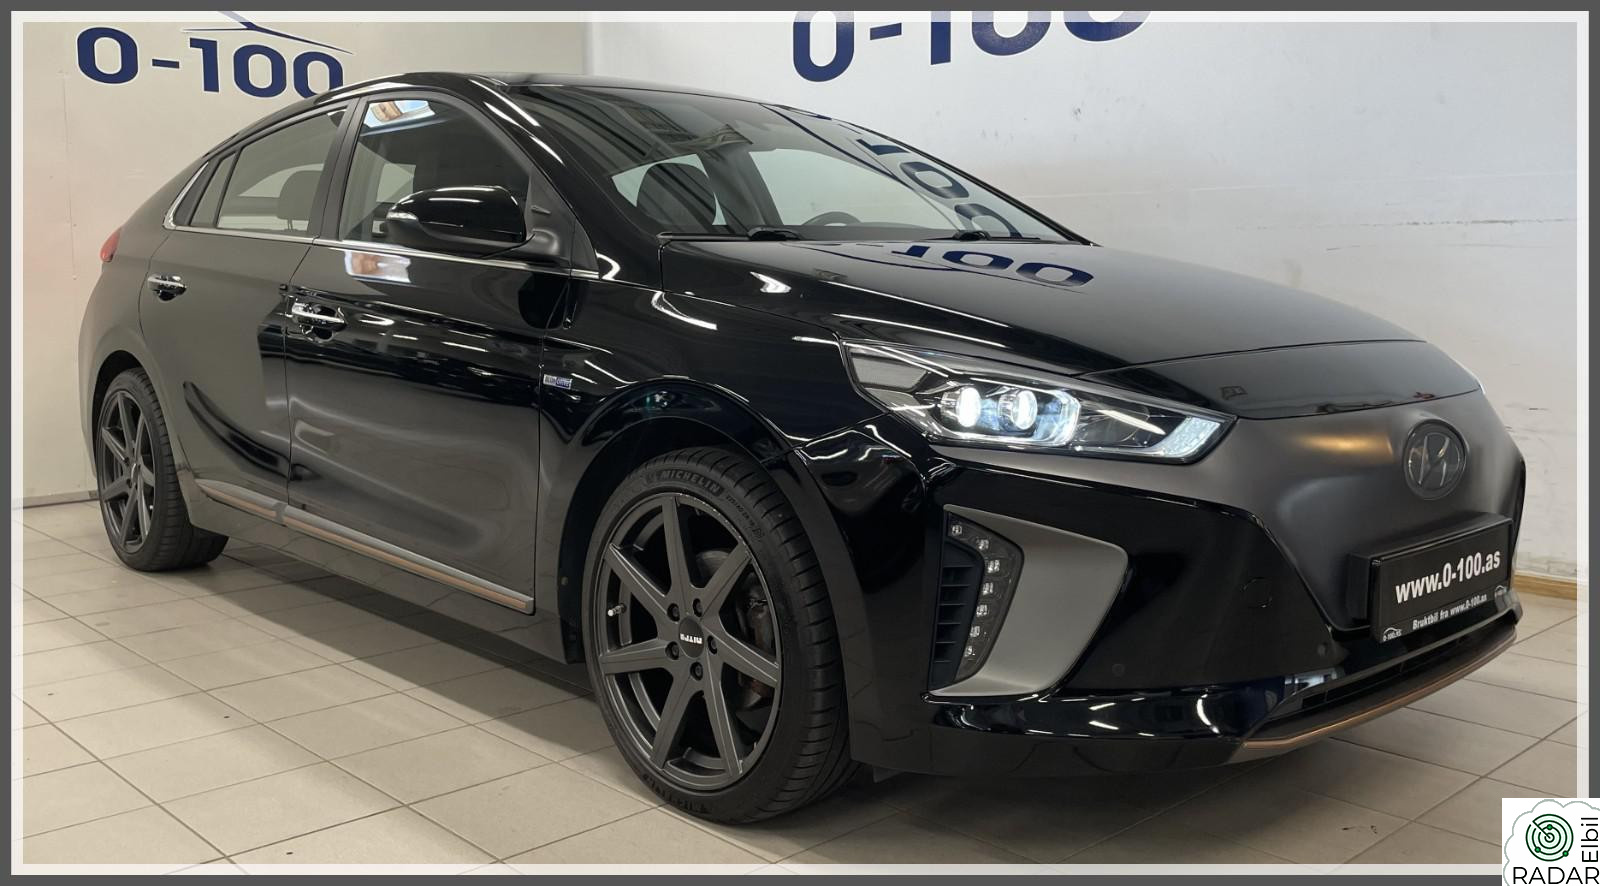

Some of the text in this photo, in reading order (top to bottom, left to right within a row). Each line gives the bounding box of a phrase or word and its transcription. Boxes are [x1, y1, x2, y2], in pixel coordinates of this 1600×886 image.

[77, 27, 343, 98] 0-100
[660, 470, 721, 494] MICHELIN
[1395, 551, 1501, 604] www.0-100.as
